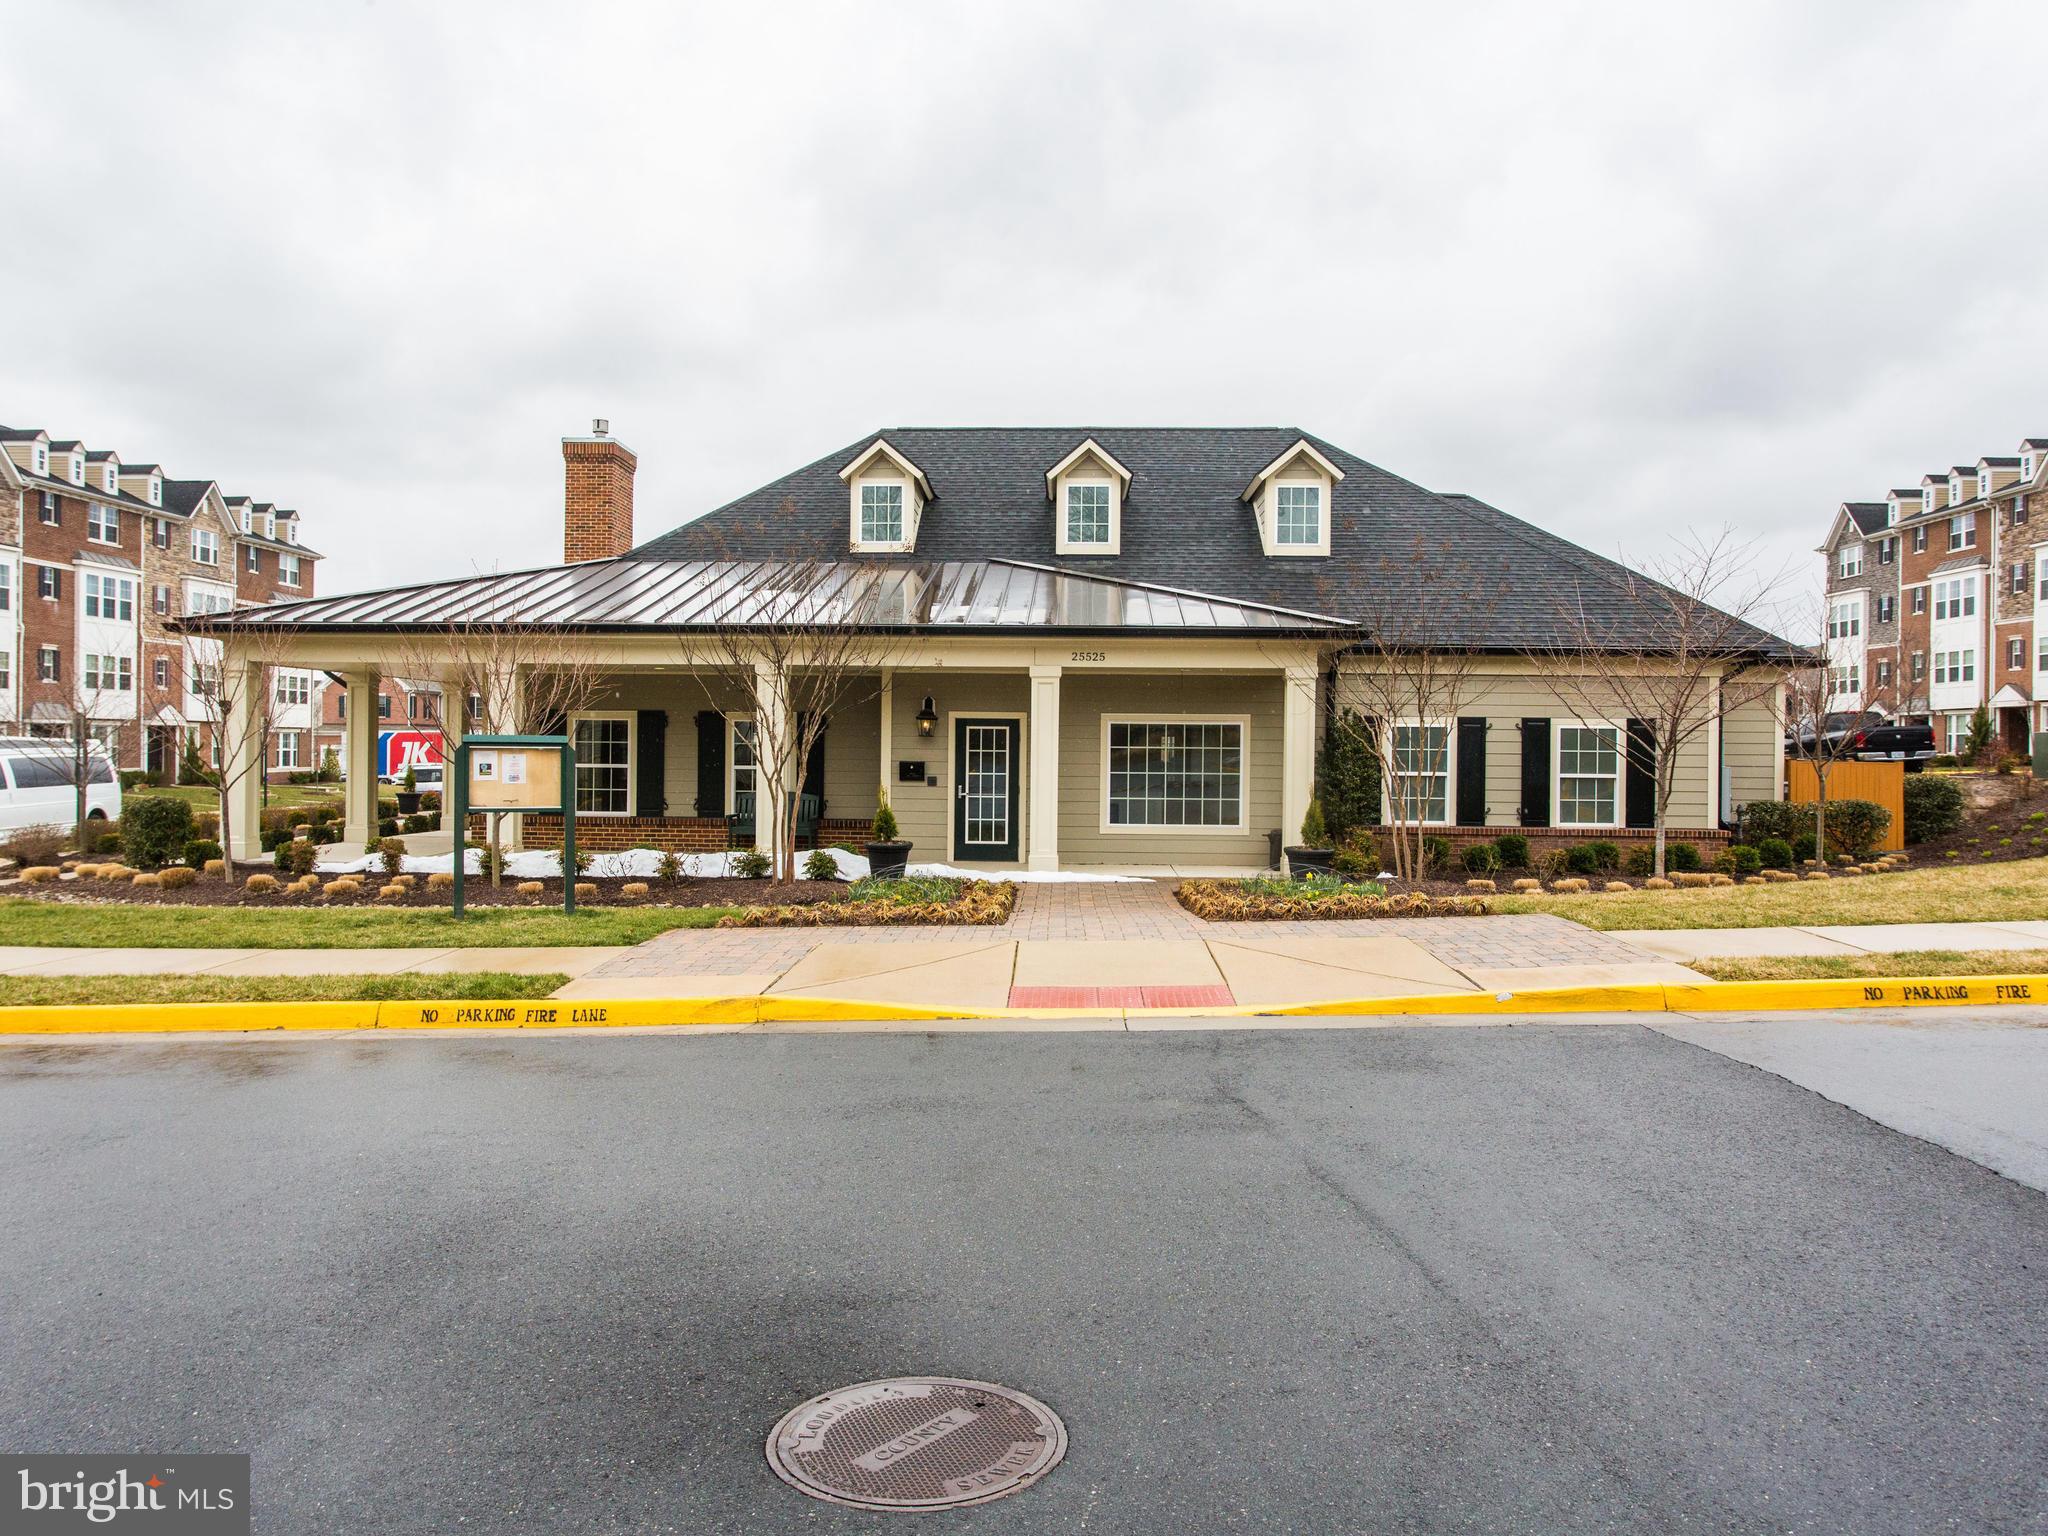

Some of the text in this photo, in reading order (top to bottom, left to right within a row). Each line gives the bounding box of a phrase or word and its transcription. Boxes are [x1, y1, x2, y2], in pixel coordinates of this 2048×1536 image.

[1071, 651, 1106, 662] 25525
[397, 741, 432, 769] JK
[1864, 984, 2031, 1000] NO PARKING FIRE
[420, 1008, 607, 1023] NO PARKING FIRE LANE
[875, 1415, 957, 1461] COUNTY
[956, 1447, 1036, 1491] SEWER
